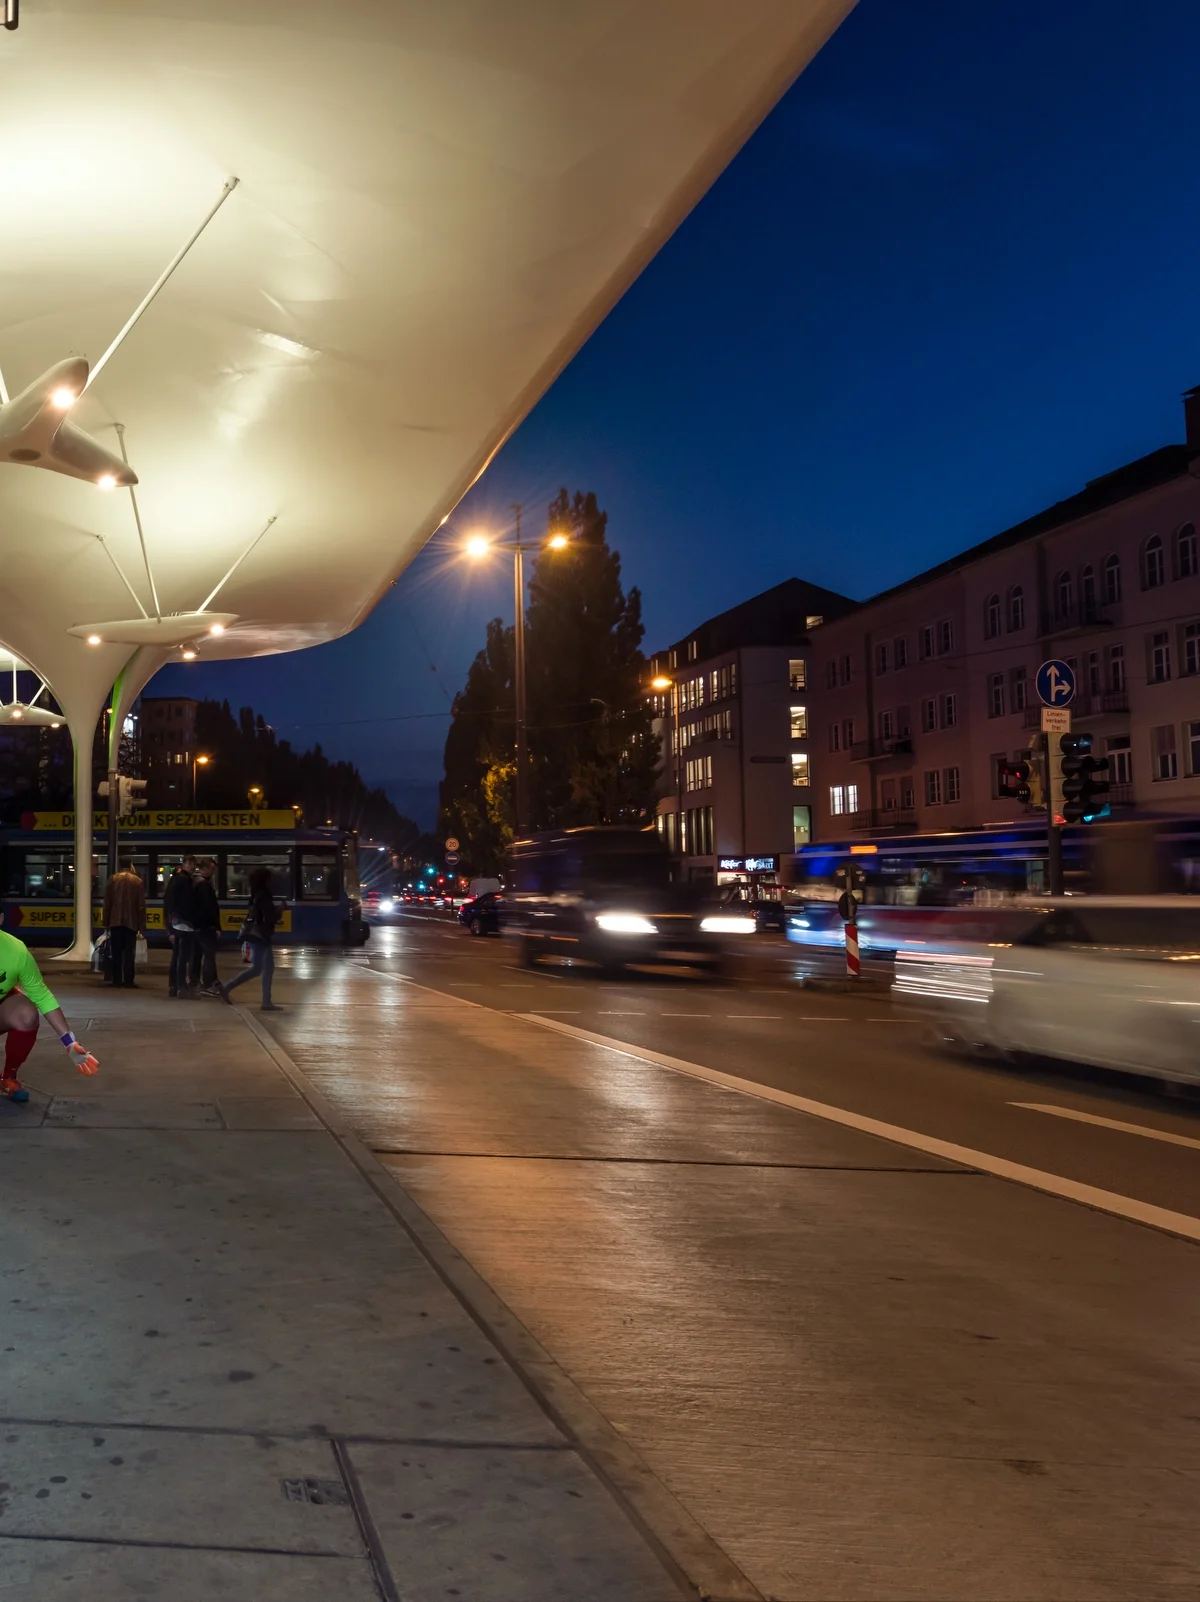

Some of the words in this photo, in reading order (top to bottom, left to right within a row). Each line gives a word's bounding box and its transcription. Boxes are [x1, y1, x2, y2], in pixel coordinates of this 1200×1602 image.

[117, 814, 150, 827] VOM
[156, 813, 260, 827] SPEZIALISTEN
[30, 911, 66, 922] SUPER
